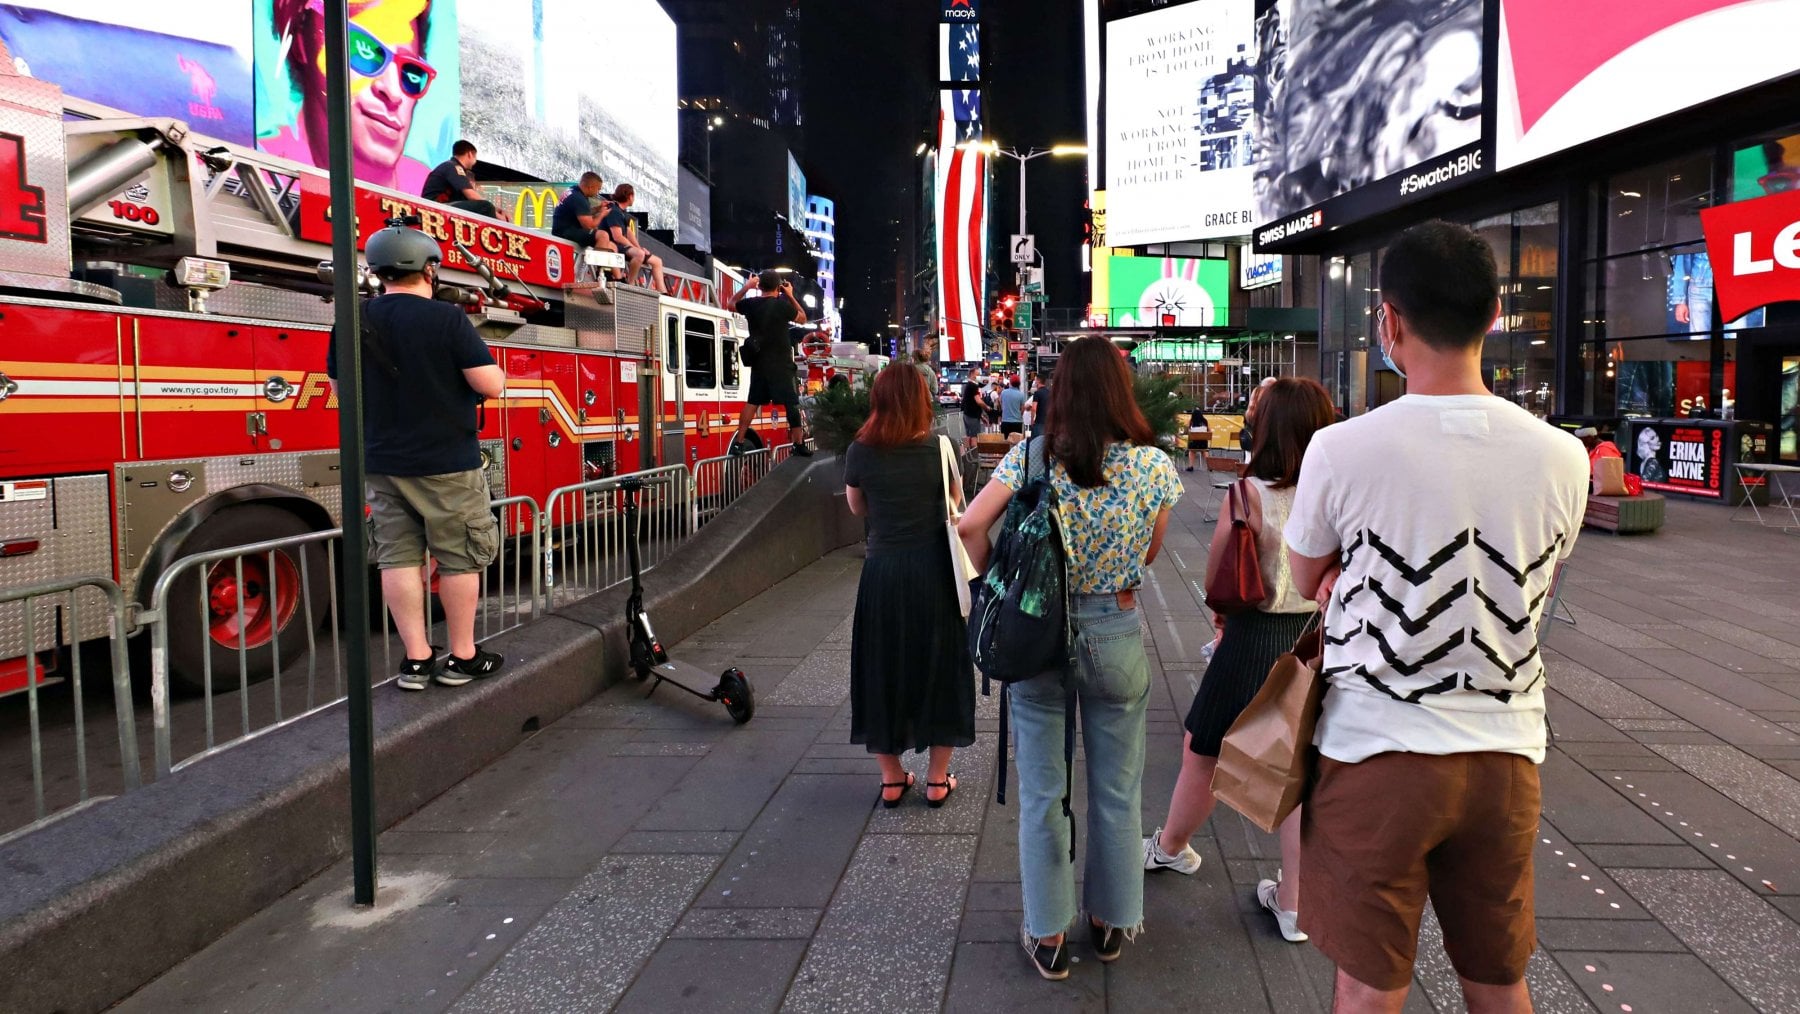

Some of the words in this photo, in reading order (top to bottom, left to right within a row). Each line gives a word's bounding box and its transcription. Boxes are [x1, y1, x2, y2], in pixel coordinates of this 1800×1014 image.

[1147, 26, 1214, 47] WORKING
[1129, 50, 1166, 66] FROM
[1173, 41, 1211, 58] HOME
[1146, 67, 1158, 78] IS
[1165, 55, 1214, 74] TOUGH
[1158, 105, 1184, 118] NOT
[1120, 124, 1187, 141] WORKING
[1148, 138, 1187, 153] FROM
[1128, 156, 1164, 171] HOME
[1116, 169, 1183, 187] TOUGHER
[107, 200, 160, 226] 100
[1205, 212, 1238, 227] GRACE
[381, 198, 532, 261] TRUCK
[1258, 225, 1285, 246] SWISS
[1286, 212, 1313, 236] MADE
[448, 250, 462, 264] OF
[161, 386, 239, 396] www.nyc.gov.fdny
[699, 410, 709, 437] 4
[1669, 440, 1705, 463] ERIKA
[1710, 429, 1722, 489] CHICAGO
[1668, 461, 1704, 481] JAYNE
